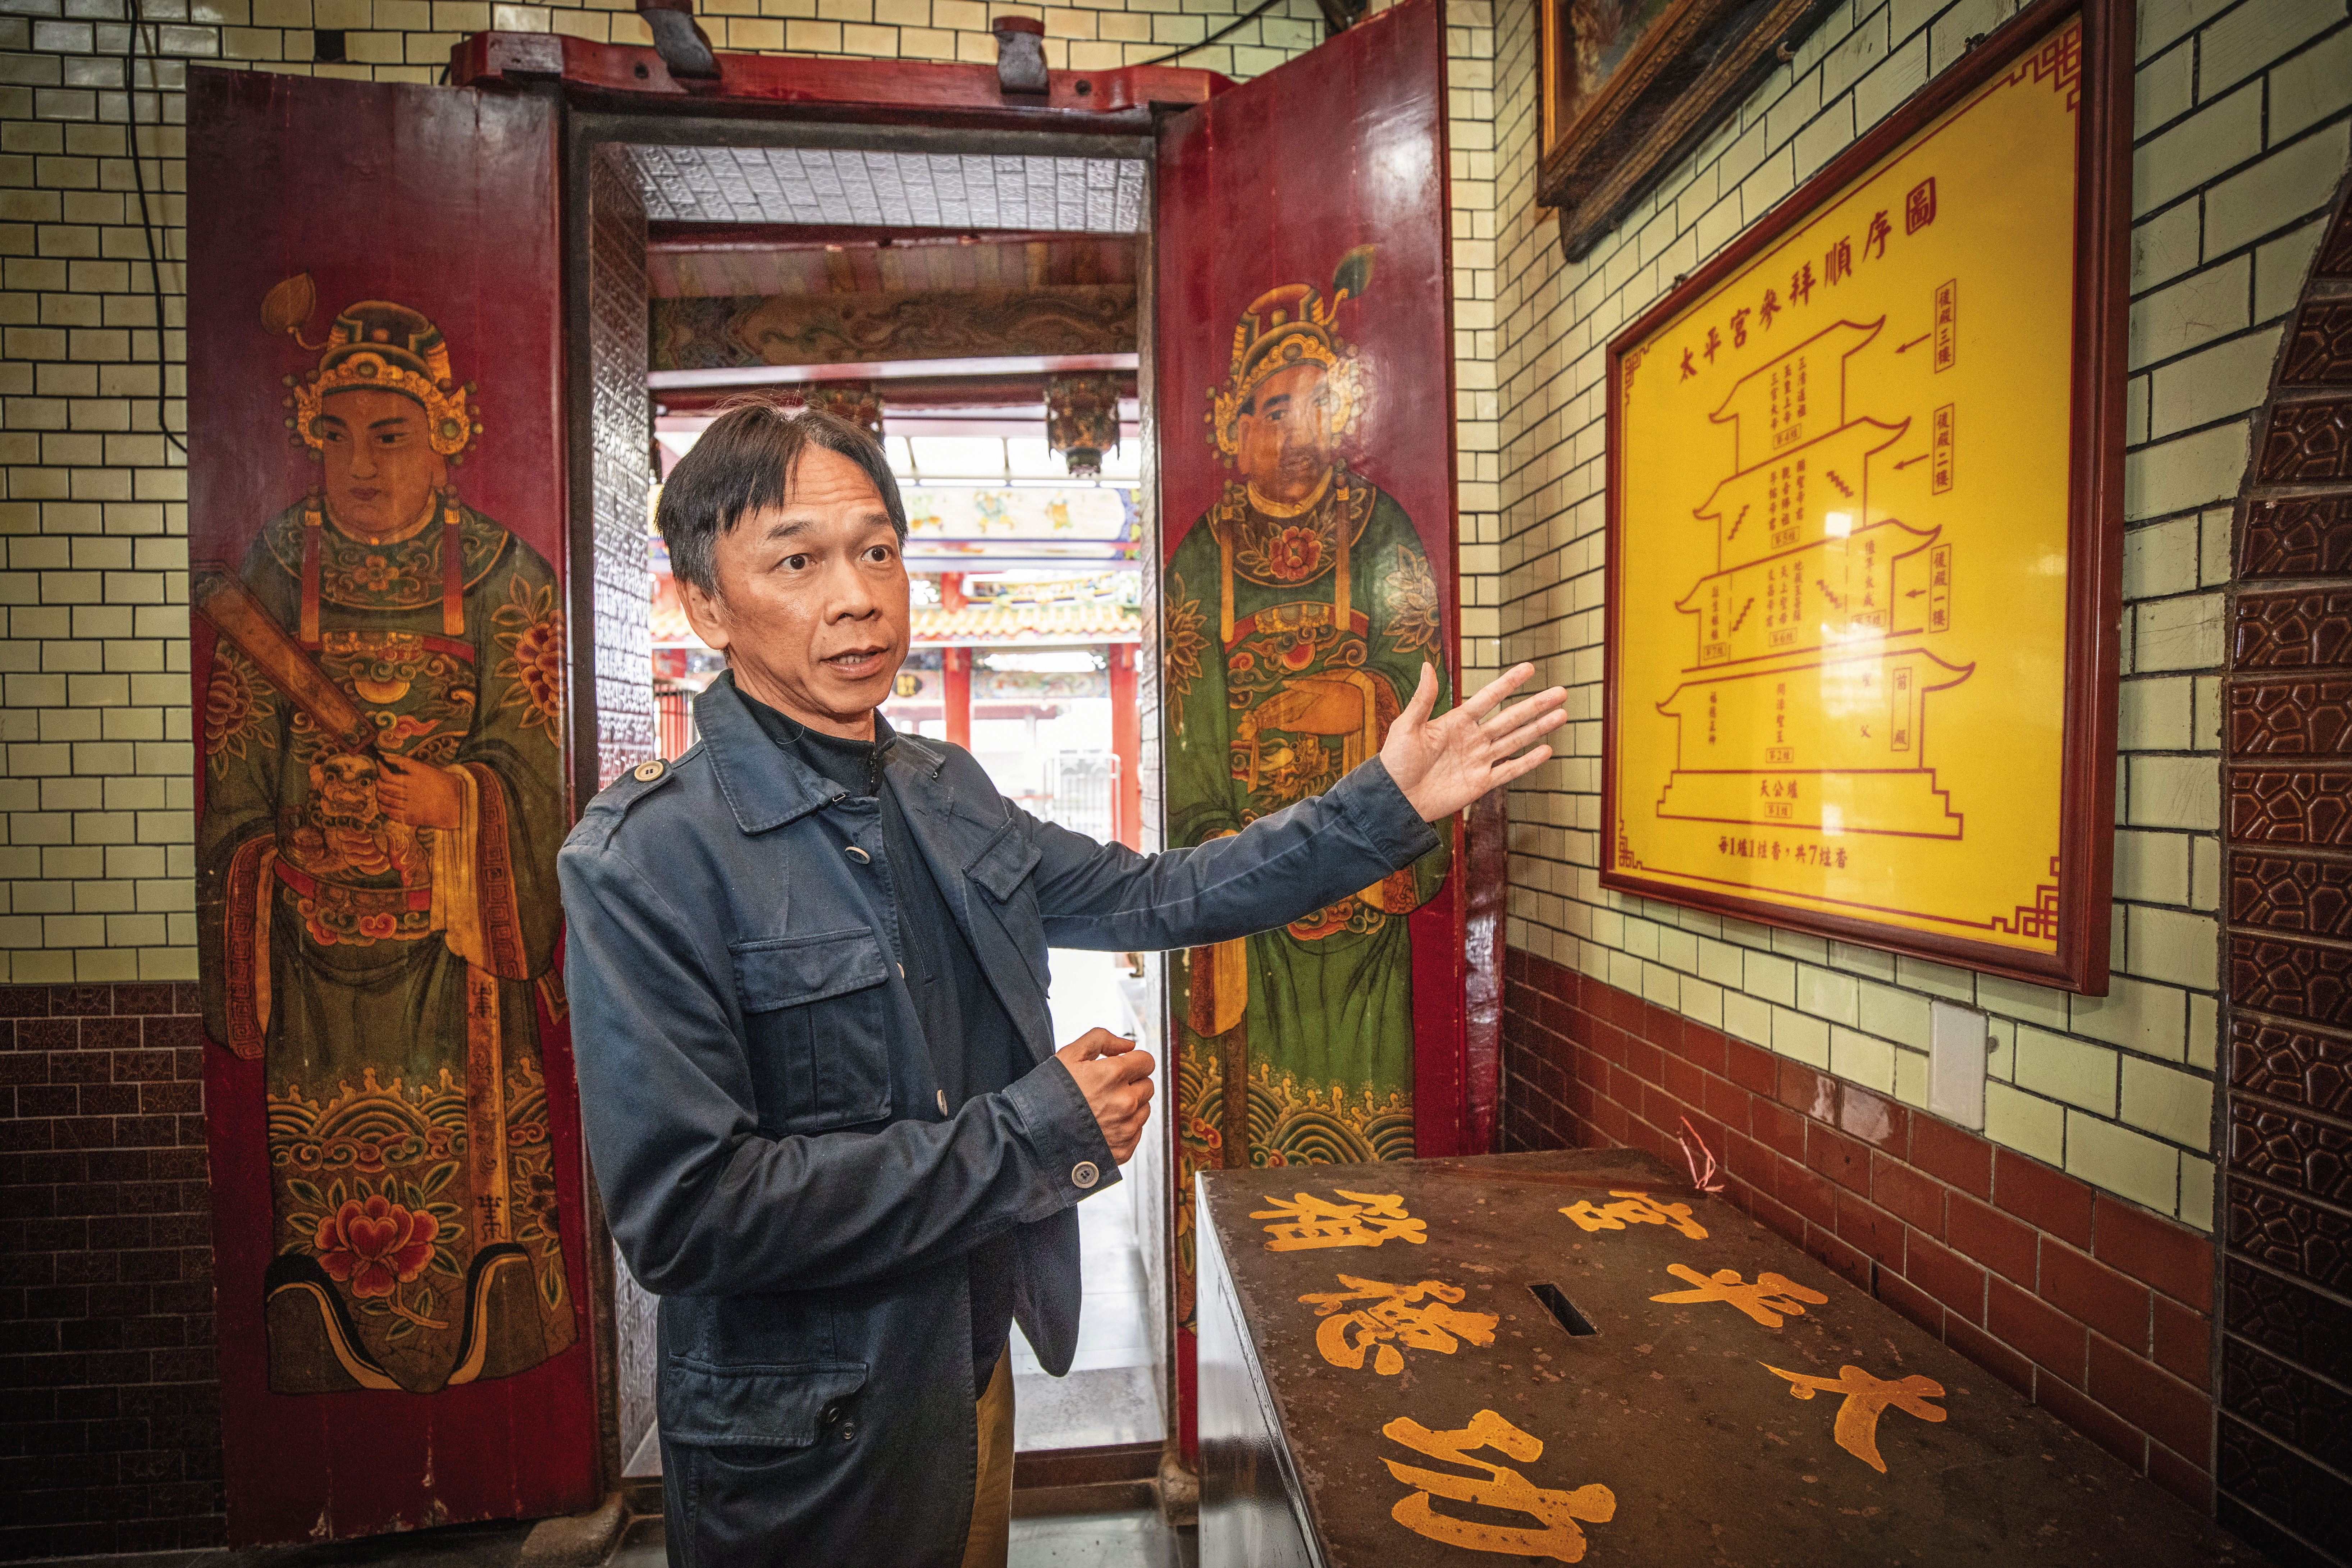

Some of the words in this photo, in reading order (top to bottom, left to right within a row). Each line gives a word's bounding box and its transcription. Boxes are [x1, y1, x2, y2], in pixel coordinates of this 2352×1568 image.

[1680, 176, 1936, 382] 太平宮參拜順序圖
[1938, 289, 1951, 365] 後殿三樓
[1935, 412, 1950, 486] 後殿二樓
[1933, 552, 1947, 625] 後殿一樓
[1760, 780, 1798, 798] 天公爐
[1558, 1188, 1946, 1473] 太平宮
[1249, 1189, 1617, 1563] 功德箱
